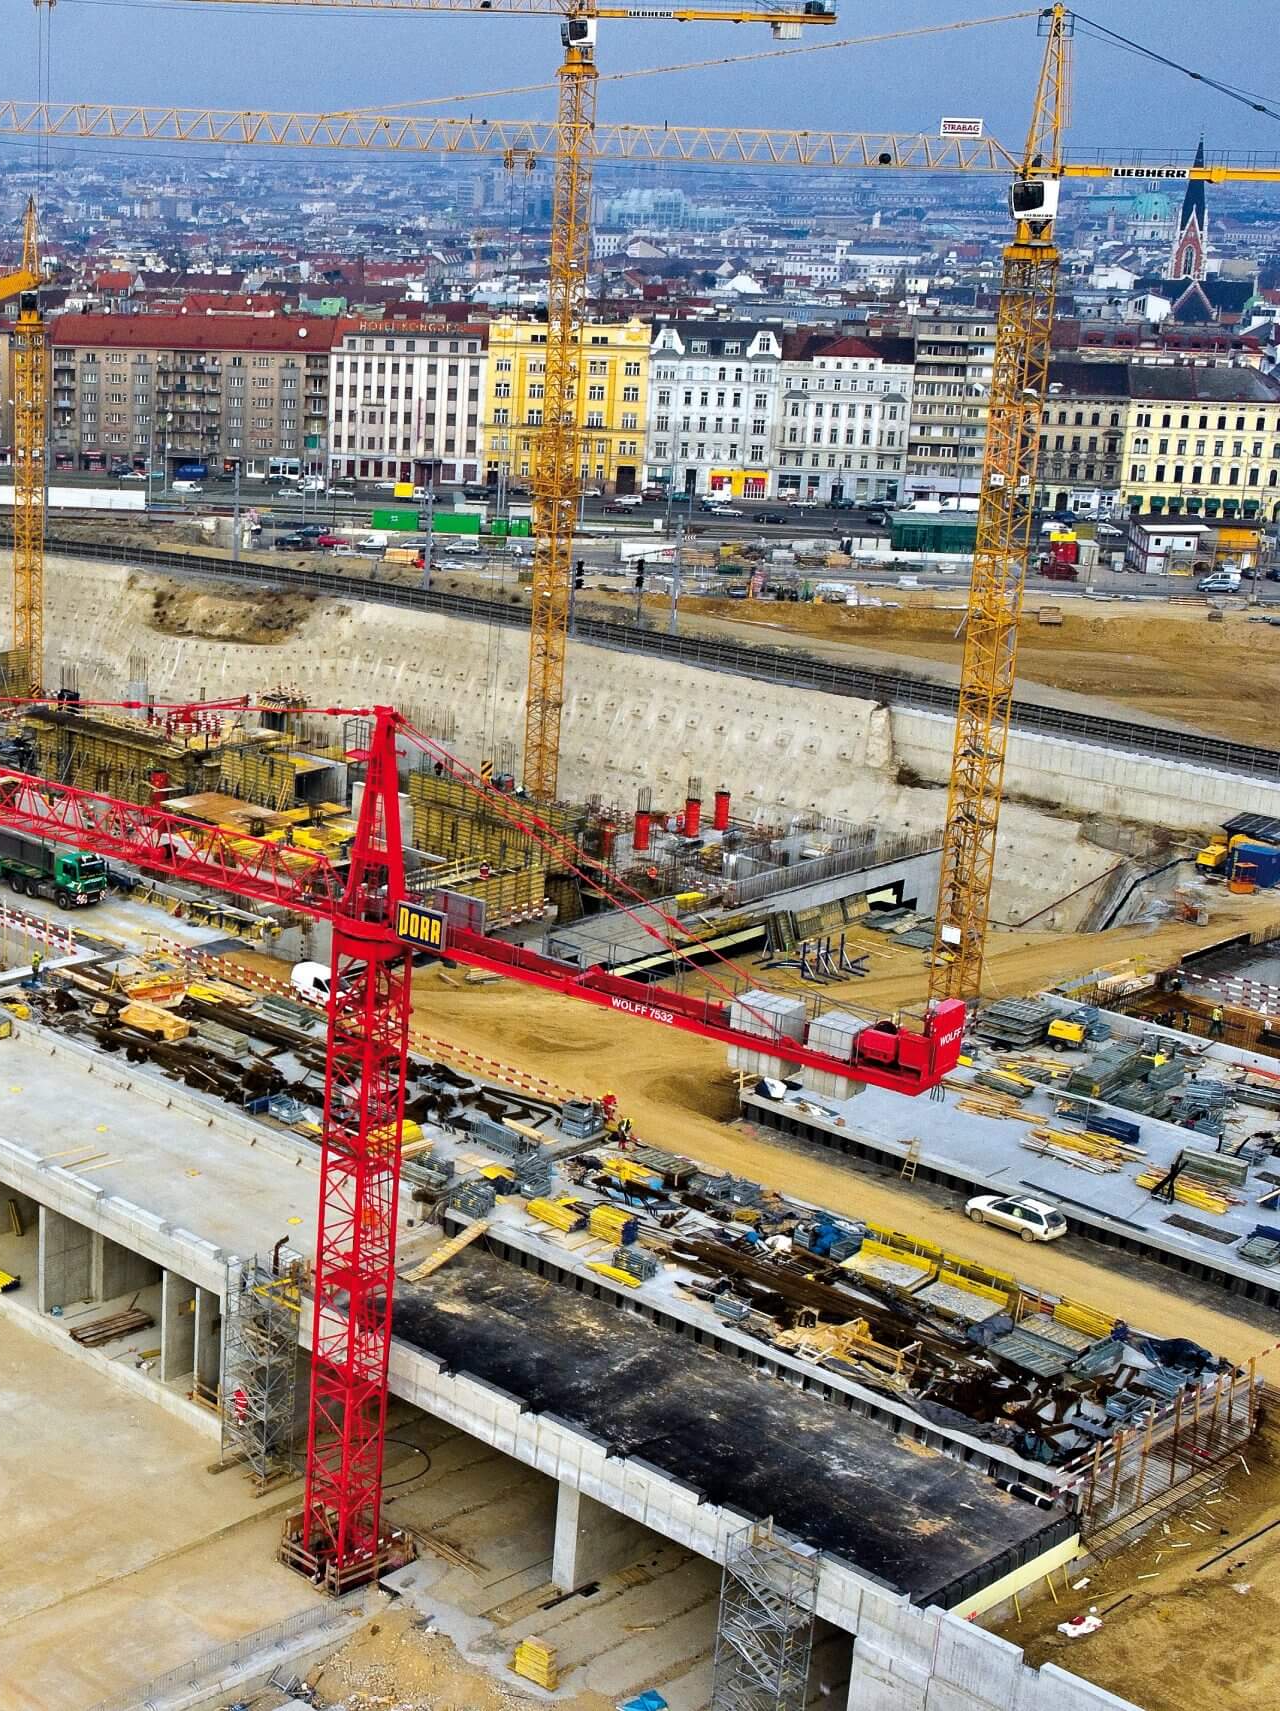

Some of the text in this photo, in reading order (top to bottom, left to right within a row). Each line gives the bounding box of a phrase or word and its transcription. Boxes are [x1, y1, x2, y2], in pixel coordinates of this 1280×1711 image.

[942, 123, 980, 132] STRABAG
[1113, 168, 1187, 178] LIEBHERR
[359, 320, 395, 333] HOTEL
[398, 906, 441, 945] PORR
[611, 996, 673, 1024] WOLFF 7532
[940, 1026, 962, 1047] WOLFF
